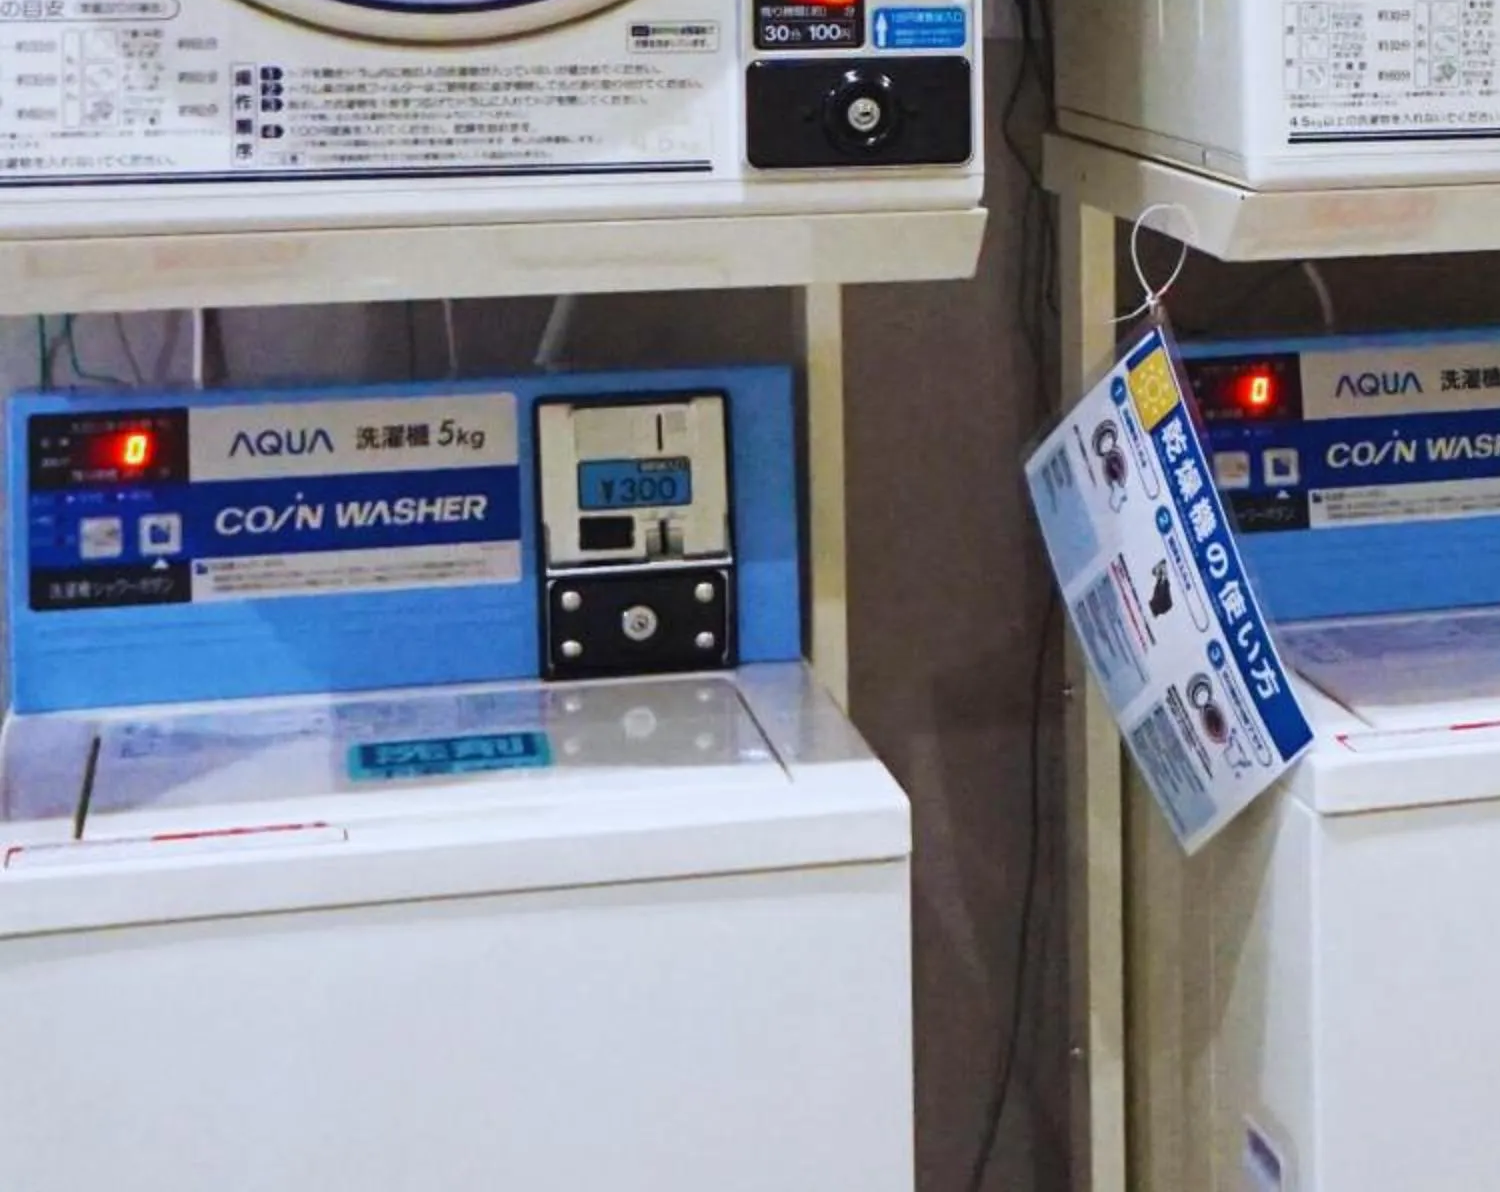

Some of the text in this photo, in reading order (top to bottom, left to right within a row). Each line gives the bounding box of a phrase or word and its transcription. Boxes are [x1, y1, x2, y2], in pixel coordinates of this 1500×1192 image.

[1251, 377, 1269, 403] 0
[1335, 371, 1424, 398] AQUA
[125, 434, 148, 465] 0
[228, 428, 335, 458] AQUA
[437, 419, 487, 450] 5kg
[1326, 429, 1417, 469] COIN
[214, 492, 488, 536] COIN WASHER
